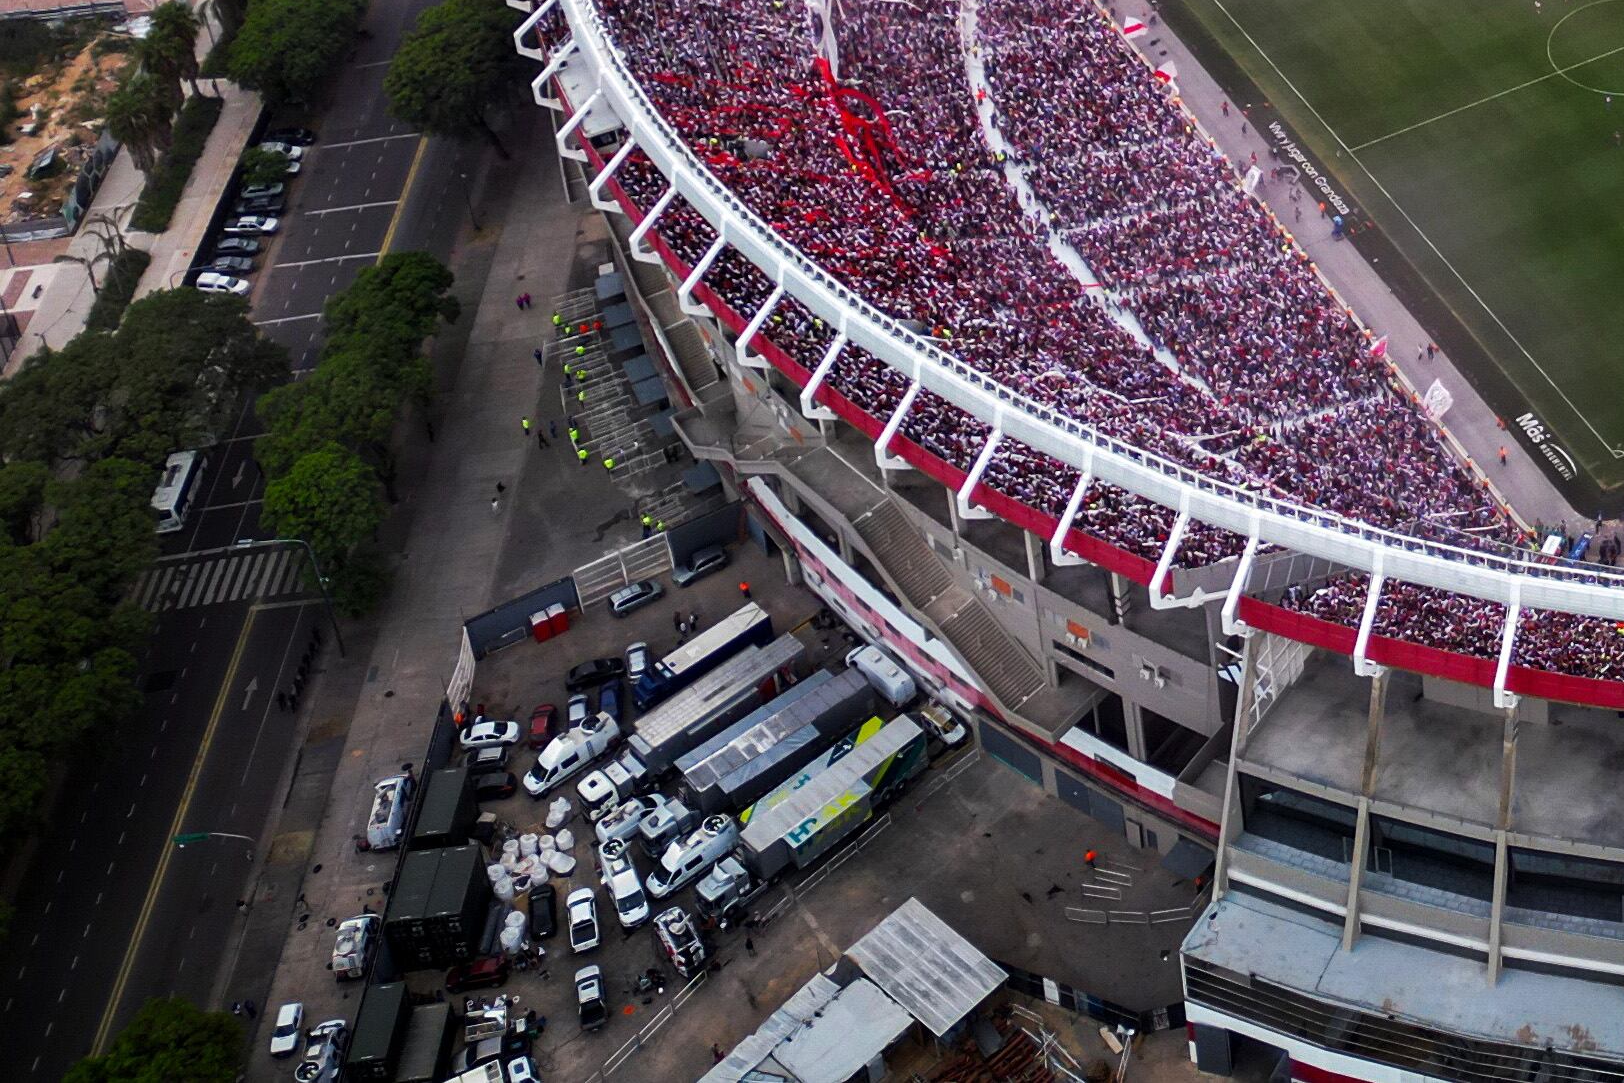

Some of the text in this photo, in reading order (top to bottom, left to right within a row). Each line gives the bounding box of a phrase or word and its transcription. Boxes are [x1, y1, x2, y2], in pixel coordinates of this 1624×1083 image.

[1282, 143, 1307, 163] jugar
[1302, 162, 1318, 179] con
[1315, 177, 1349, 215] Grandeza
